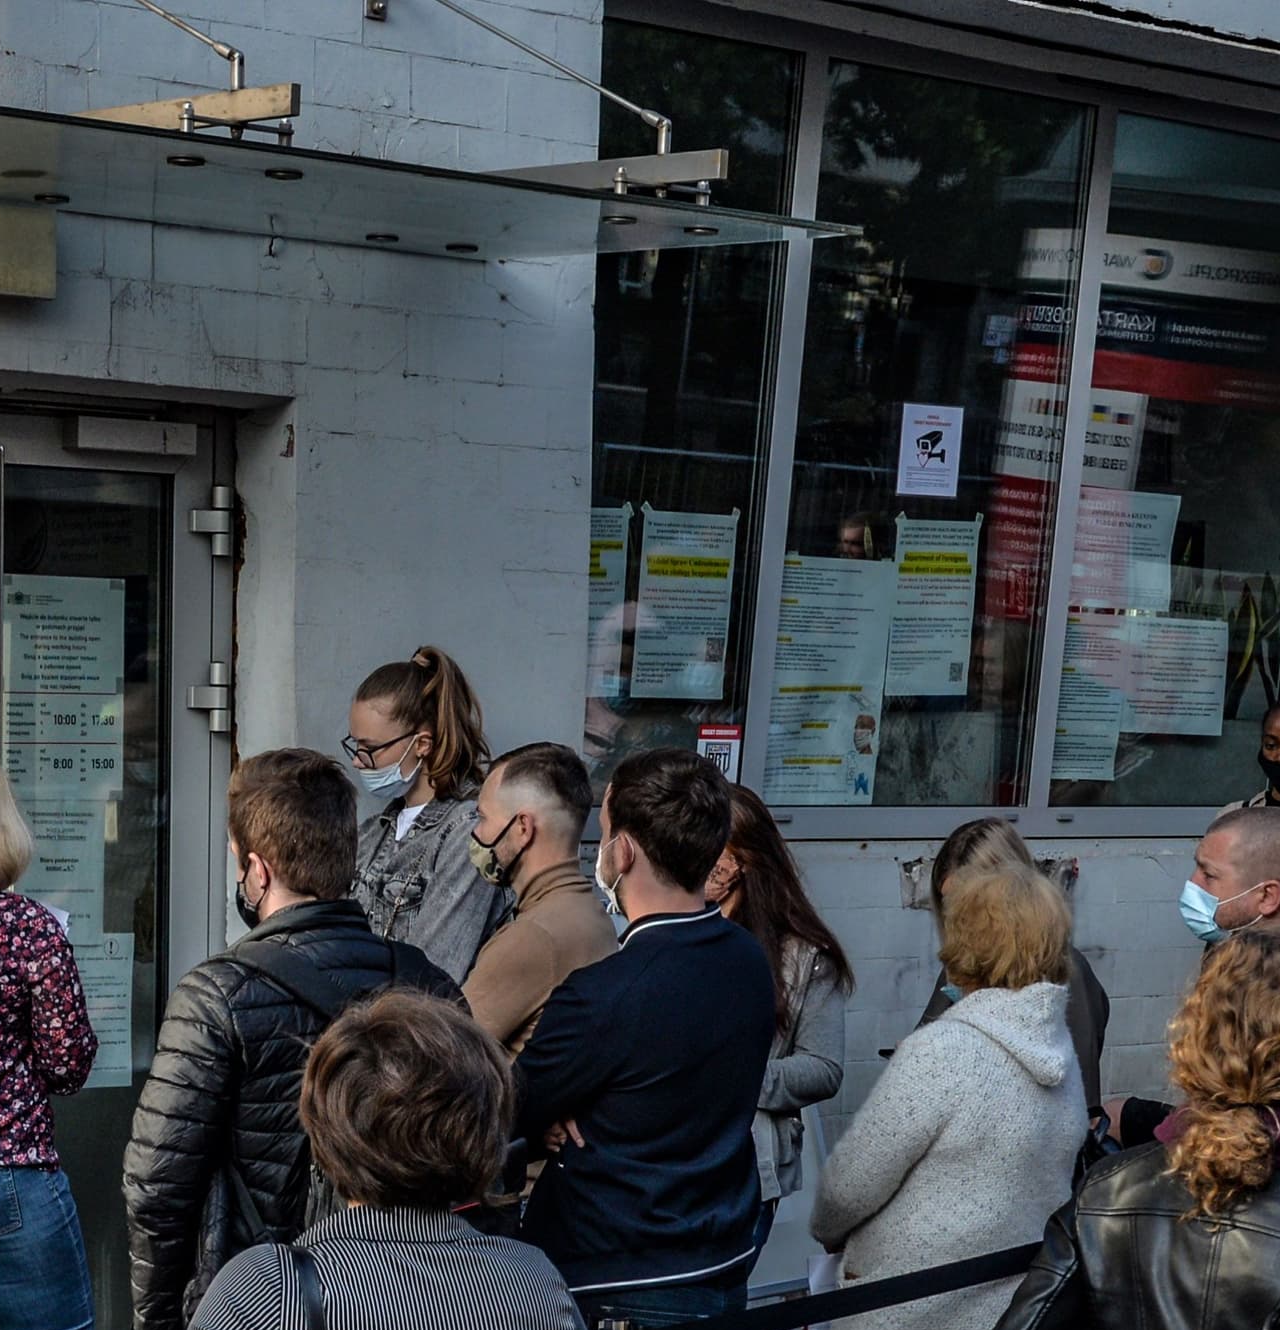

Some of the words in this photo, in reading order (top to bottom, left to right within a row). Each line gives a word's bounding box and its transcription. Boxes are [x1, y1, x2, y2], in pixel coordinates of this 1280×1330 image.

[53, 714, 76, 725] 10:00
[53, 758, 73, 769] 8:00
[91, 758, 115, 769] 15:00
